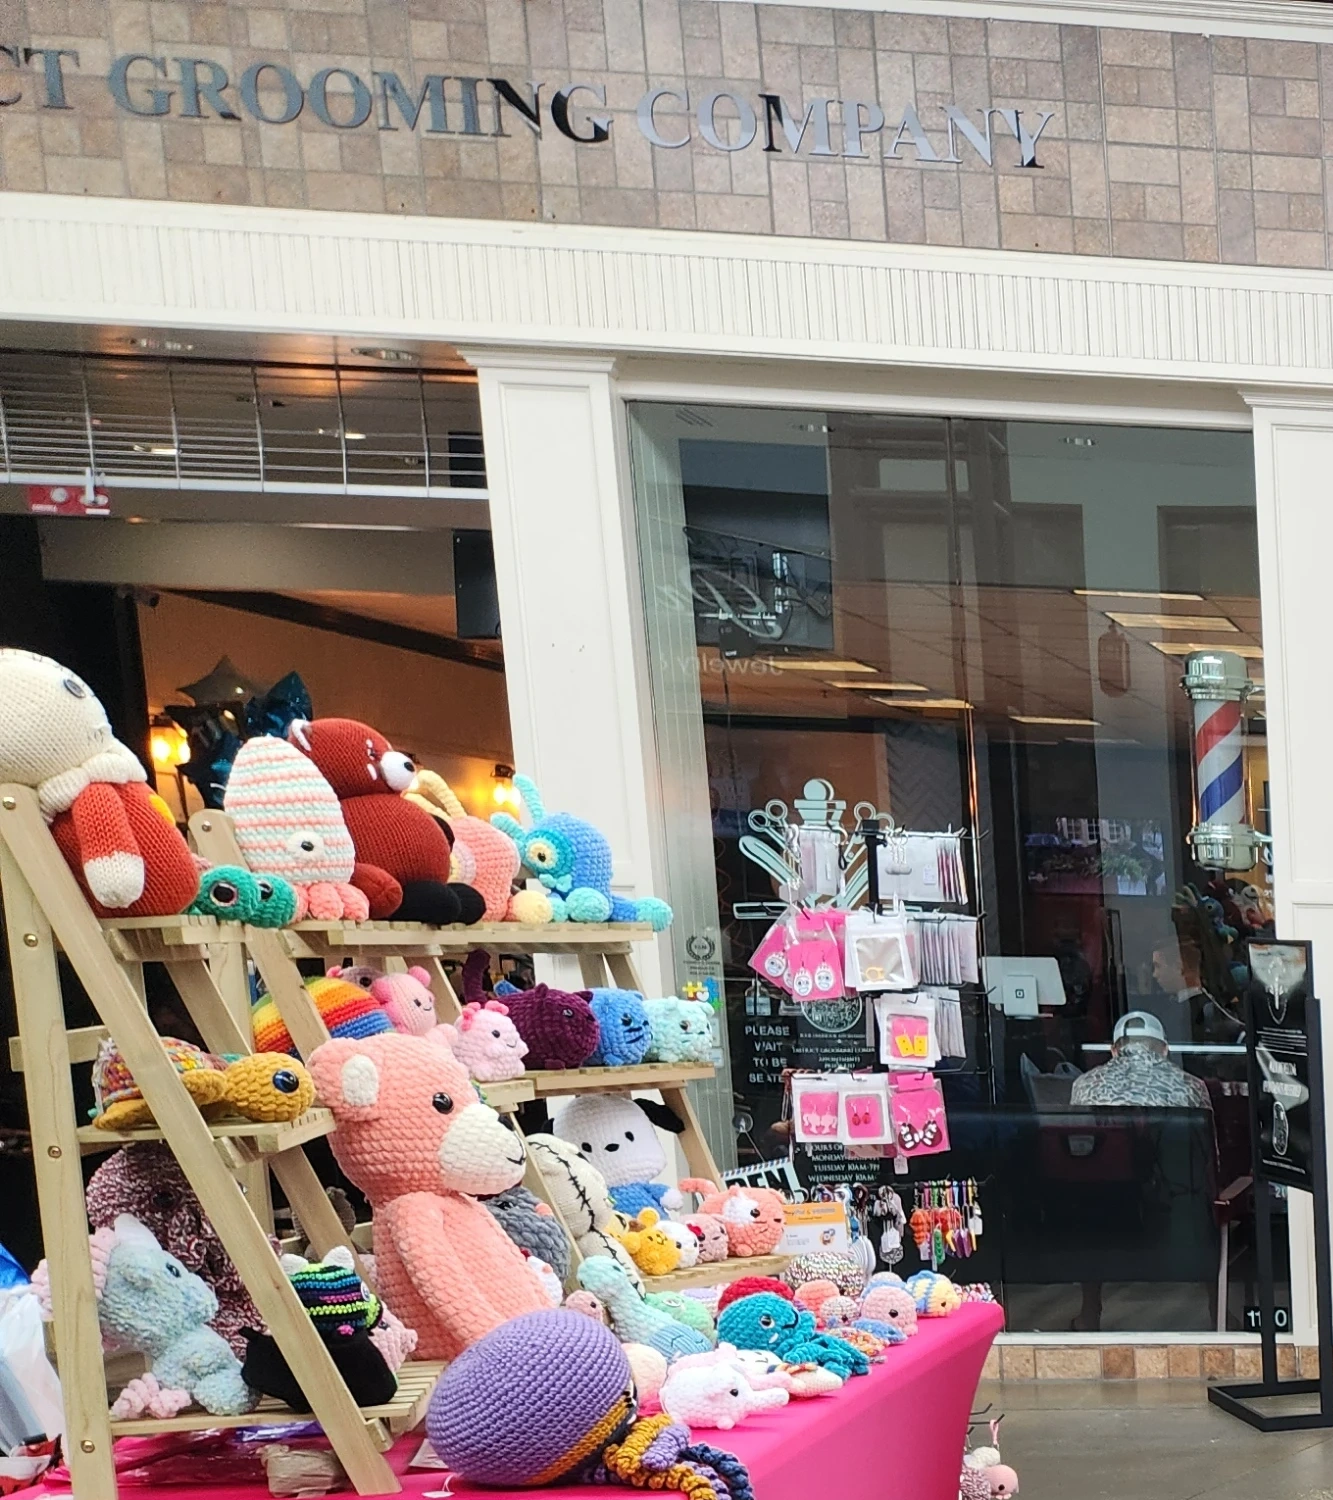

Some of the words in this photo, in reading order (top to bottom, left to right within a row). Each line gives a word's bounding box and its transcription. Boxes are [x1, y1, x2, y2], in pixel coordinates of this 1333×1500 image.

[106, 53, 613, 143] GROOMING
[636, 87, 1055, 169] COMPANY
[744, 1025, 790, 1036] PLEASE
[754, 1041, 782, 1052] WAIT
[772, 1057, 787, 1068] BE
[1247, 1309, 1287, 1327] 110
